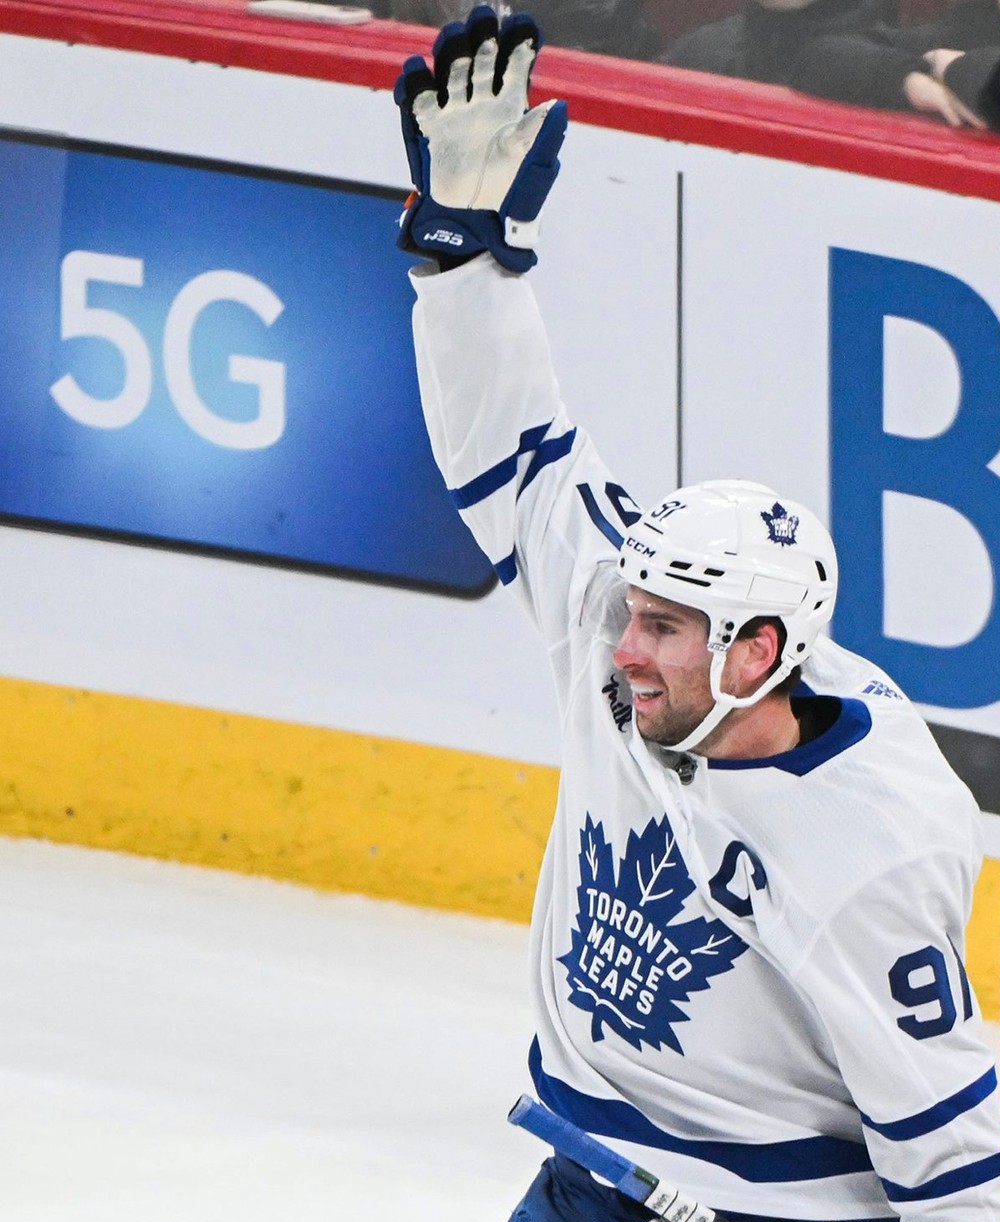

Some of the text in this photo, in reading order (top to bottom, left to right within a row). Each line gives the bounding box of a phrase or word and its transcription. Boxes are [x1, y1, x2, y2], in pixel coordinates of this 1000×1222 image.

[49, 249, 287, 451] 5G
[625, 536, 657, 559] CCM
[650, 499, 688, 521] 91
[708, 840, 767, 918] C
[586, 888, 693, 981] TORONTO
[587, 919, 665, 991] MAPLE
[578, 944, 655, 1015] LEAFS
[888, 932, 973, 1040] 91
